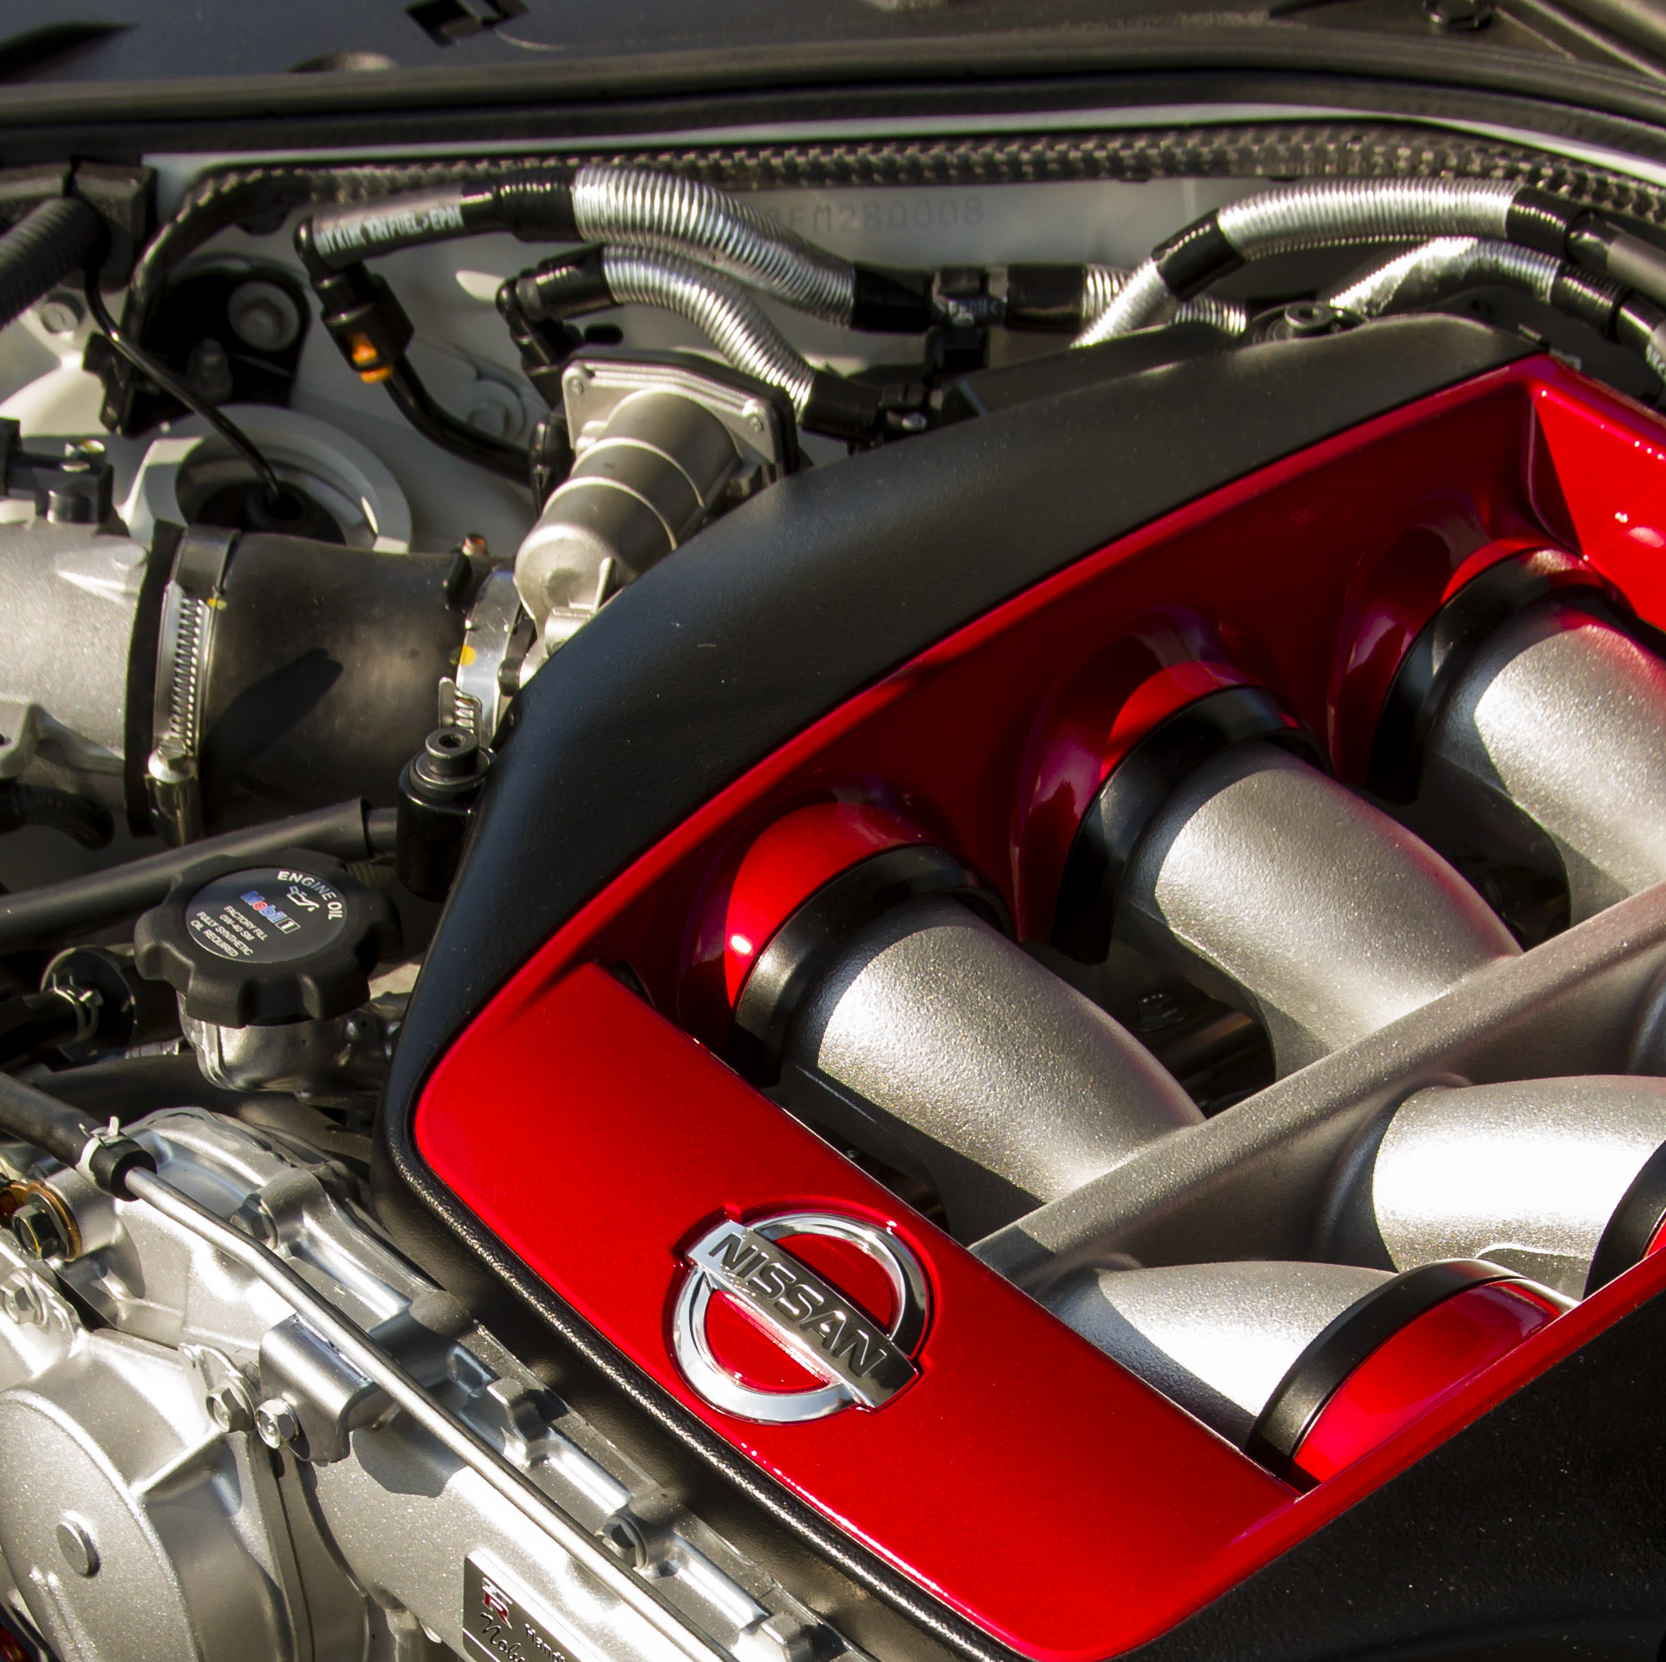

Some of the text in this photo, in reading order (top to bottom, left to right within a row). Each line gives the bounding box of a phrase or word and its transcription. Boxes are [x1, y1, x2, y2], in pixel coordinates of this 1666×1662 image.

[240, 890, 287, 923] Mobil
[277, 871, 343, 920] ENGINE OIL
[190, 919, 239, 957] OIL REQUIRED
[196, 911, 254, 956] FULLY SYNTHETIC
[223, 905, 269, 941] FACTORY FILL
[240, 929, 255, 941] SM
[709, 1232, 887, 1377] NISSAN
